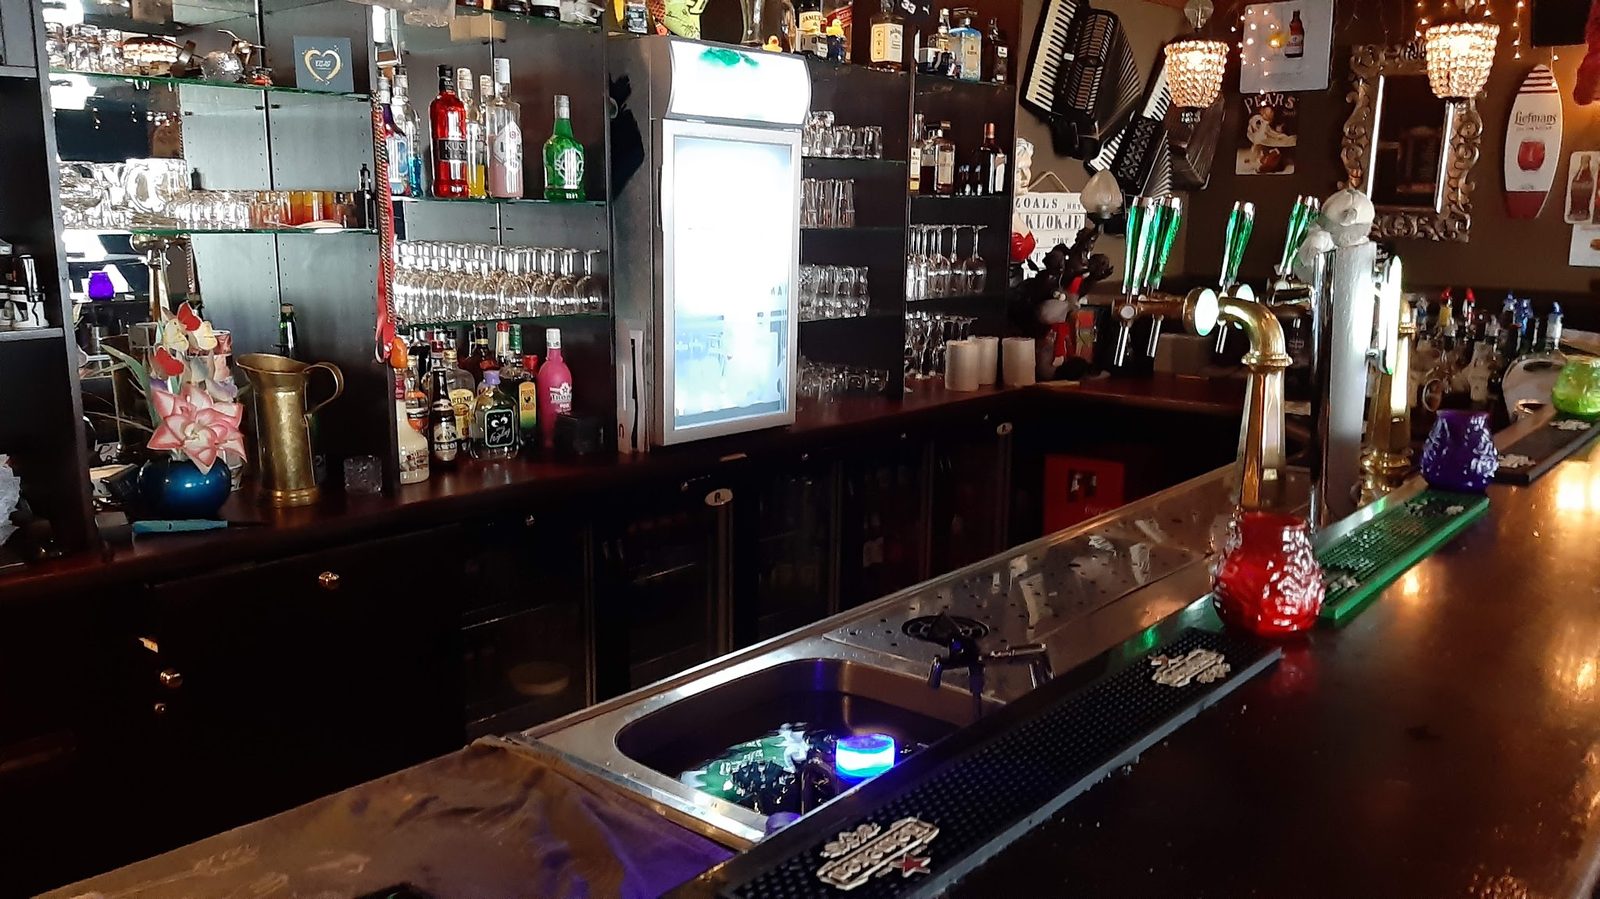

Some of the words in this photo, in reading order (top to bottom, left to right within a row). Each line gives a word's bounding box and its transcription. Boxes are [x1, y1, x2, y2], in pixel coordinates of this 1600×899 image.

[901, 0, 916, 14] 33
[1514, 111, 1557, 126] Liefmans
[1015, 197, 1058, 209] ZOALS
[1025, 214, 1082, 230] KLOKJE
